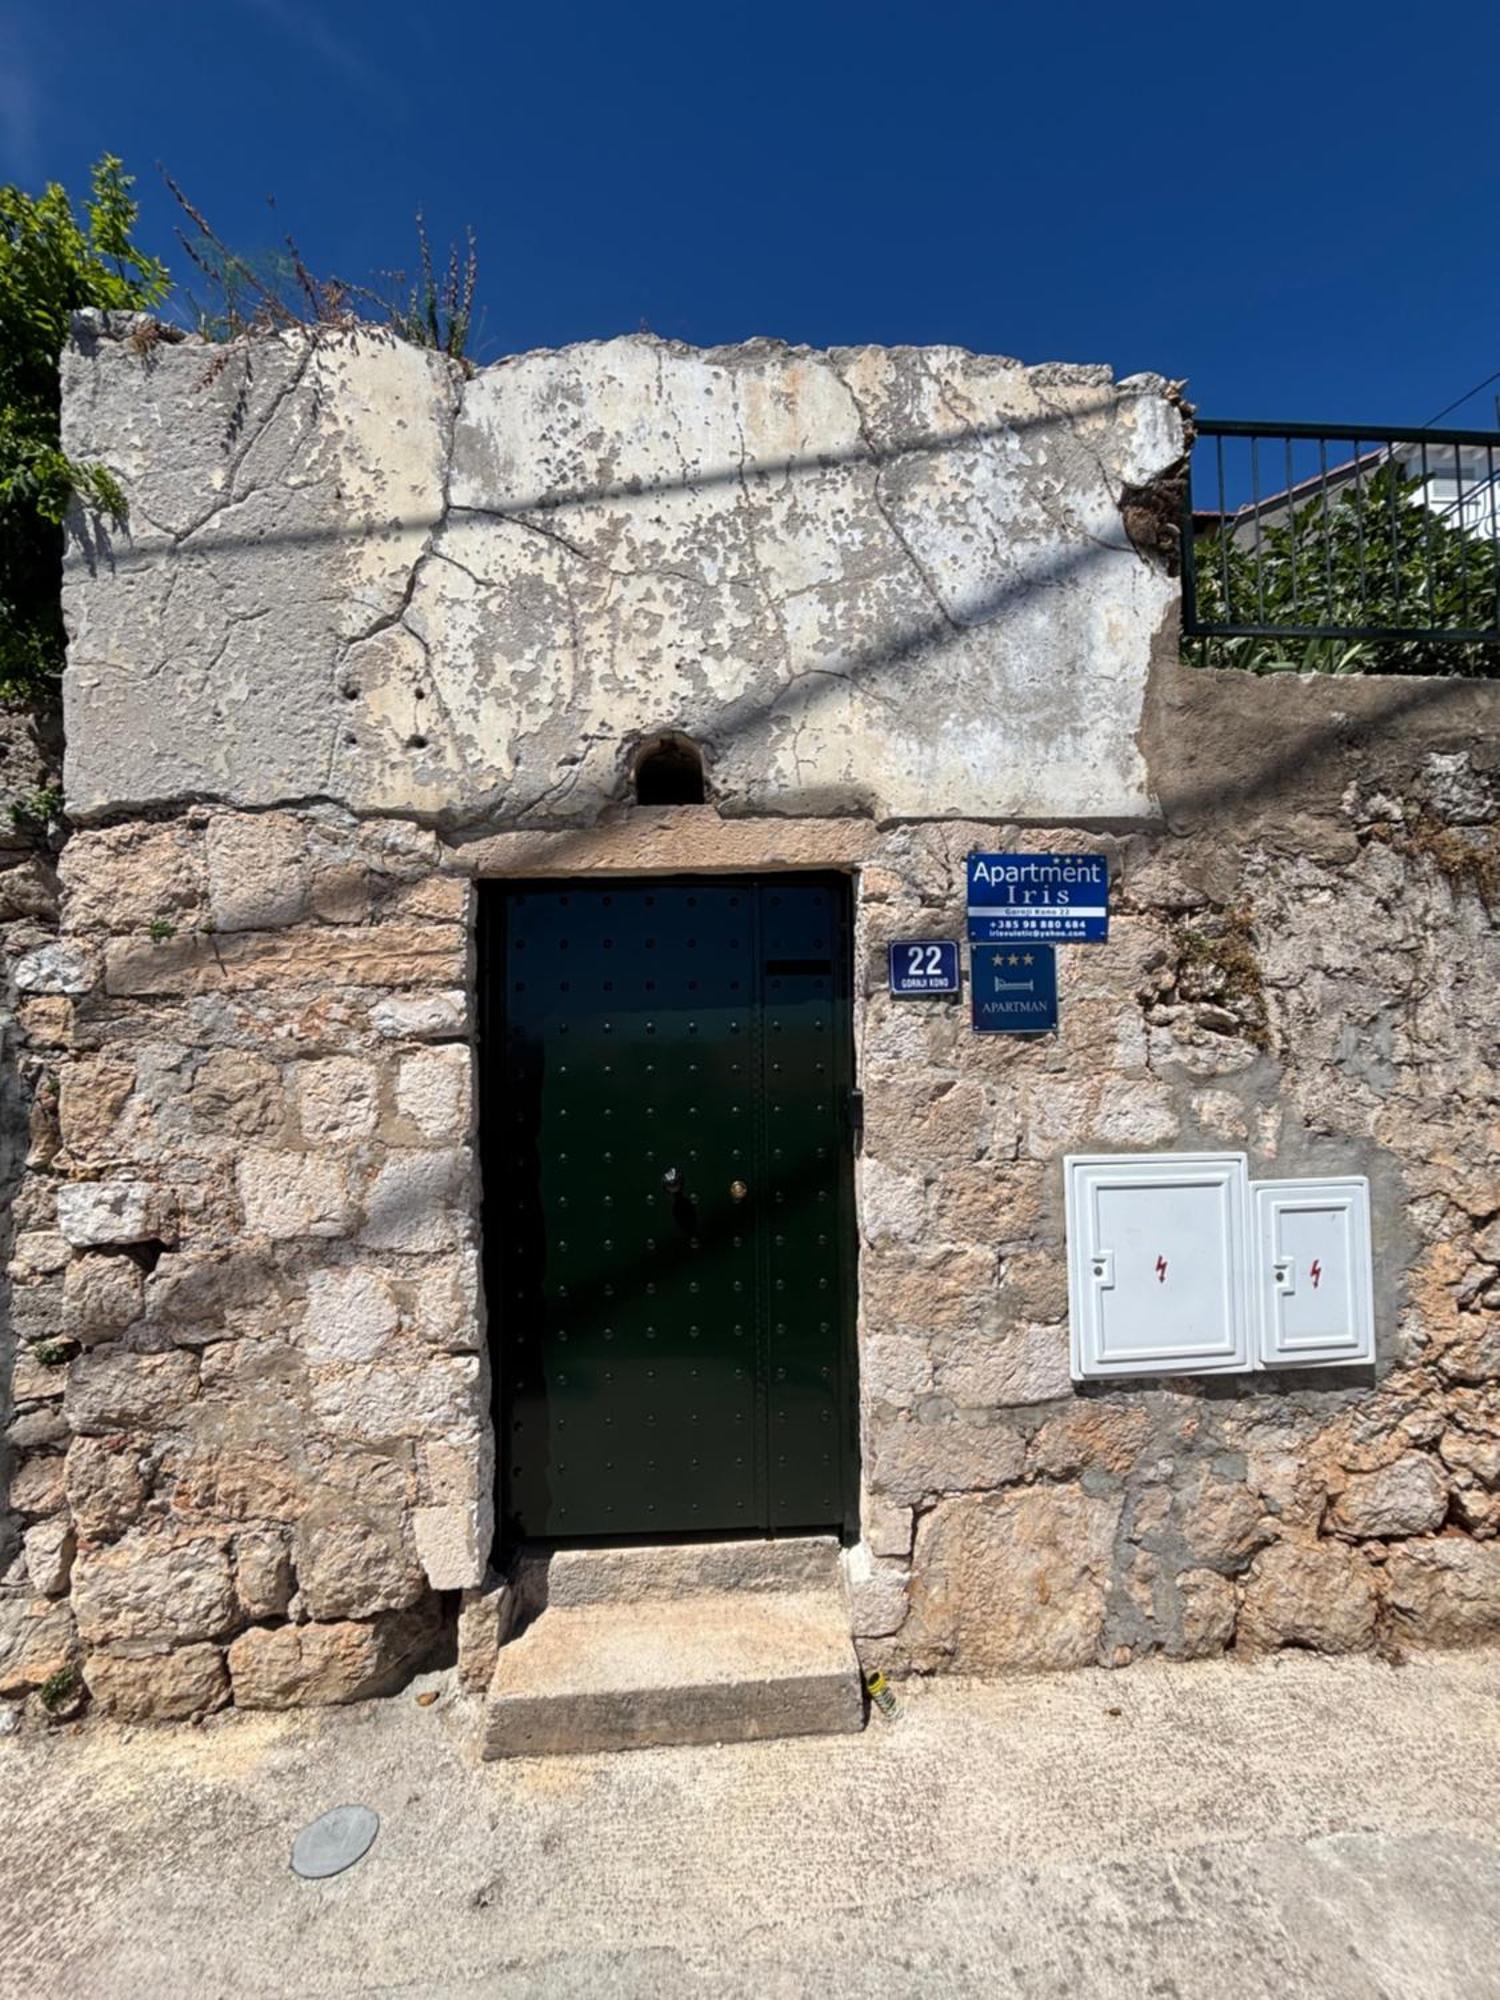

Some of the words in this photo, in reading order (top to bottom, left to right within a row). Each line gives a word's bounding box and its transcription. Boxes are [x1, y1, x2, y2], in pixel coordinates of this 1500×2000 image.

[973, 861, 1101, 887] Apartment
[1007, 885, 1070, 904] Iris
[989, 920, 1019, 929] +385
[1022, 920, 1037, 929] 98
[907, 946, 942, 975] 22
[901, 978, 928, 988] GORNJI
[929, 977, 949, 988] KONO
[982, 1001, 1048, 1013] APARTMAN
